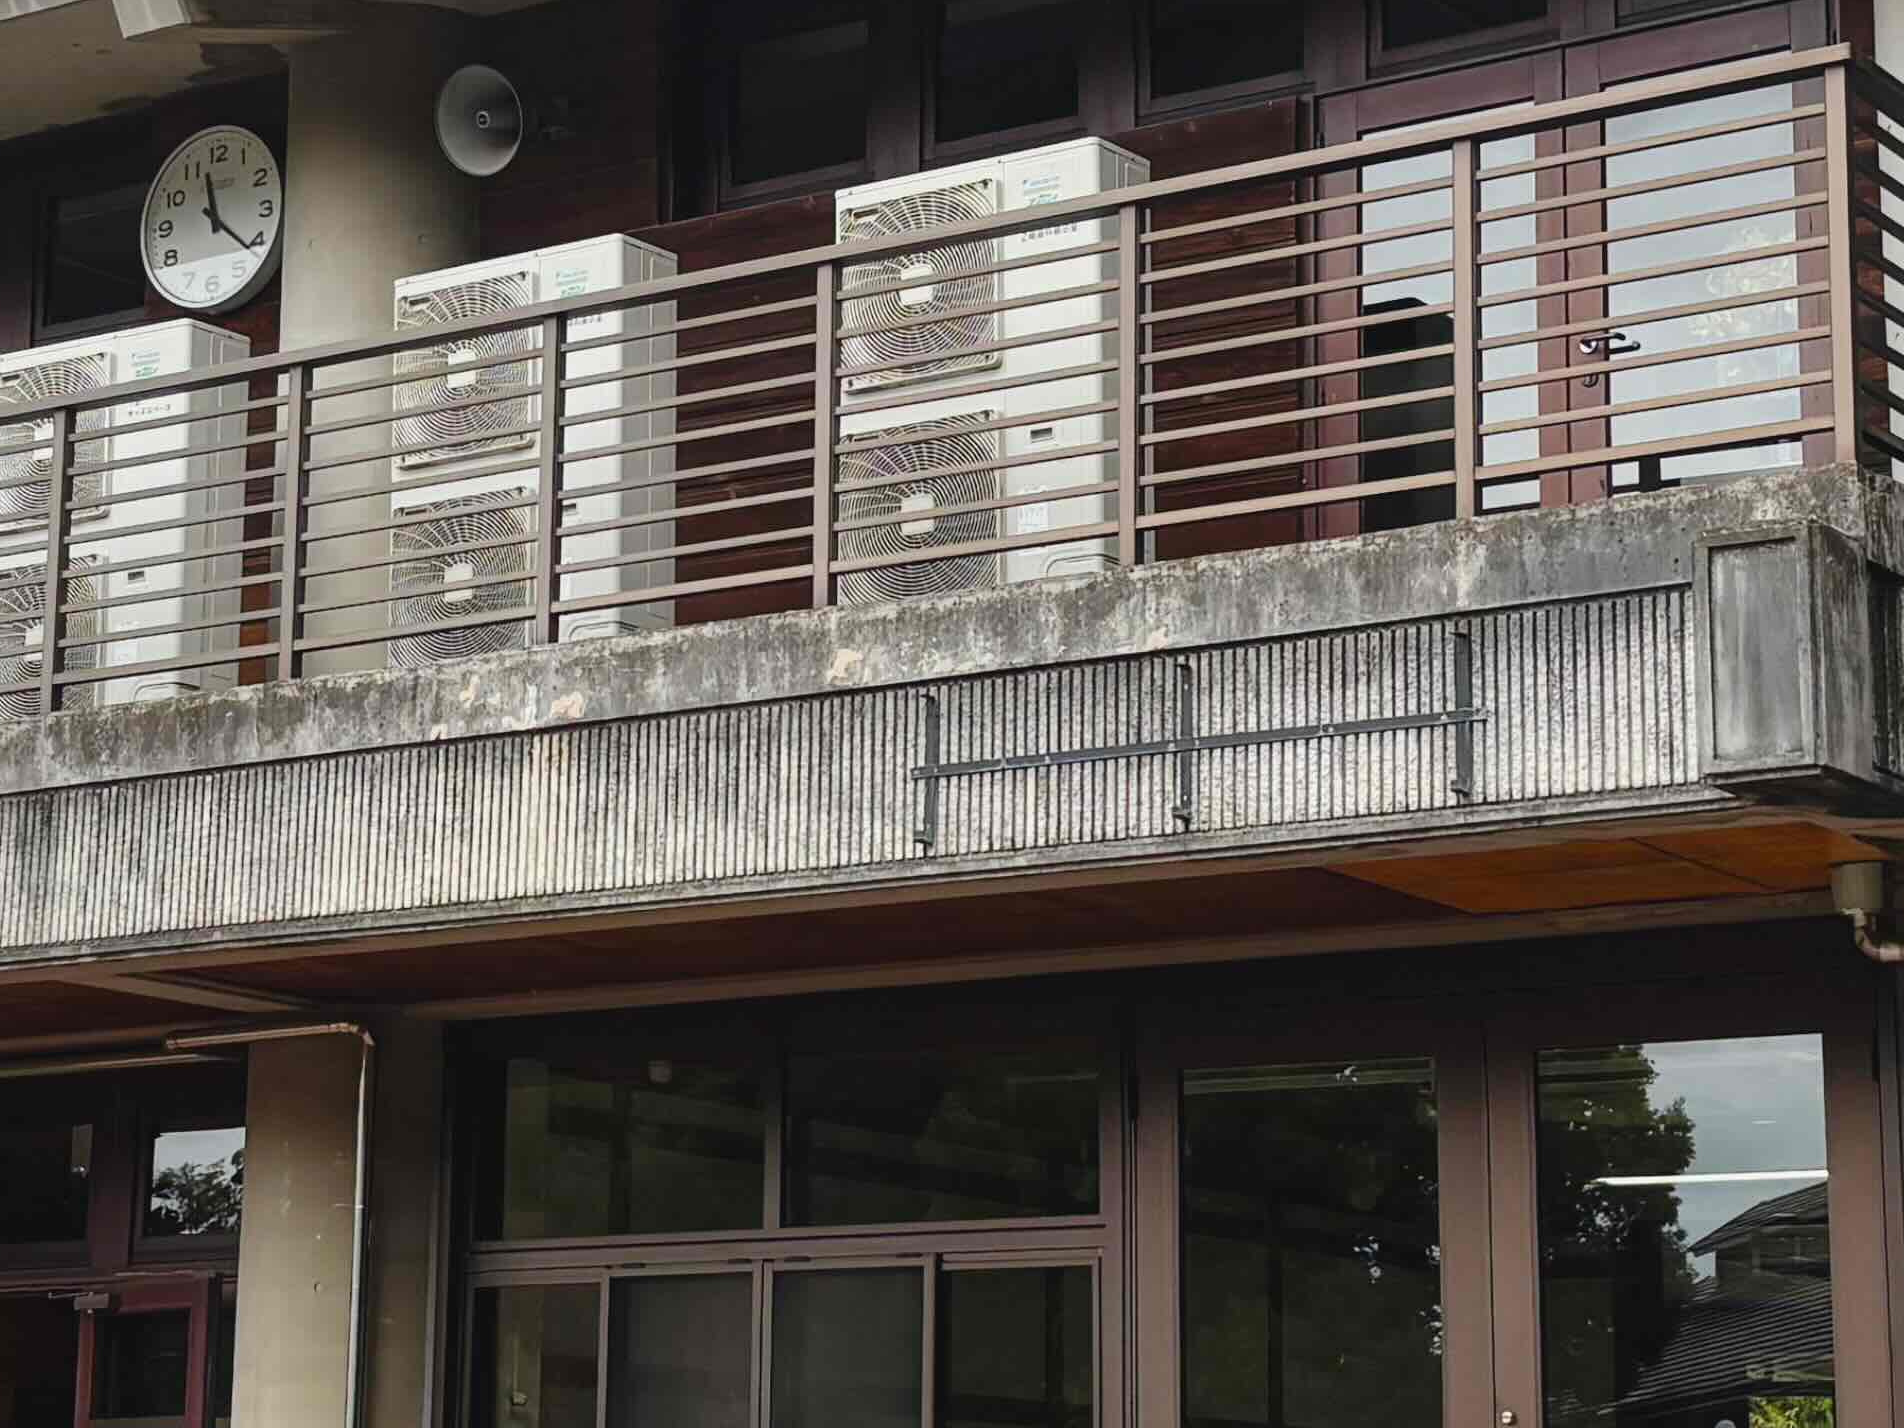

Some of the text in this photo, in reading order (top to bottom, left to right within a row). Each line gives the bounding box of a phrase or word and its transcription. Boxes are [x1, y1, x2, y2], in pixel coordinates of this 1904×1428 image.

[209, 144, 229, 164] 12
[241, 148, 246, 165] 1
[184, 162, 200, 180] 11
[253, 168, 268, 187] 2
[167, 190, 186, 208] 10
[258, 200, 273, 218] 3
[158, 220, 173, 238] 9
[250, 231, 266, 247] 4
[163, 249, 178, 267] 8
[205, 275, 219, 292] 6
